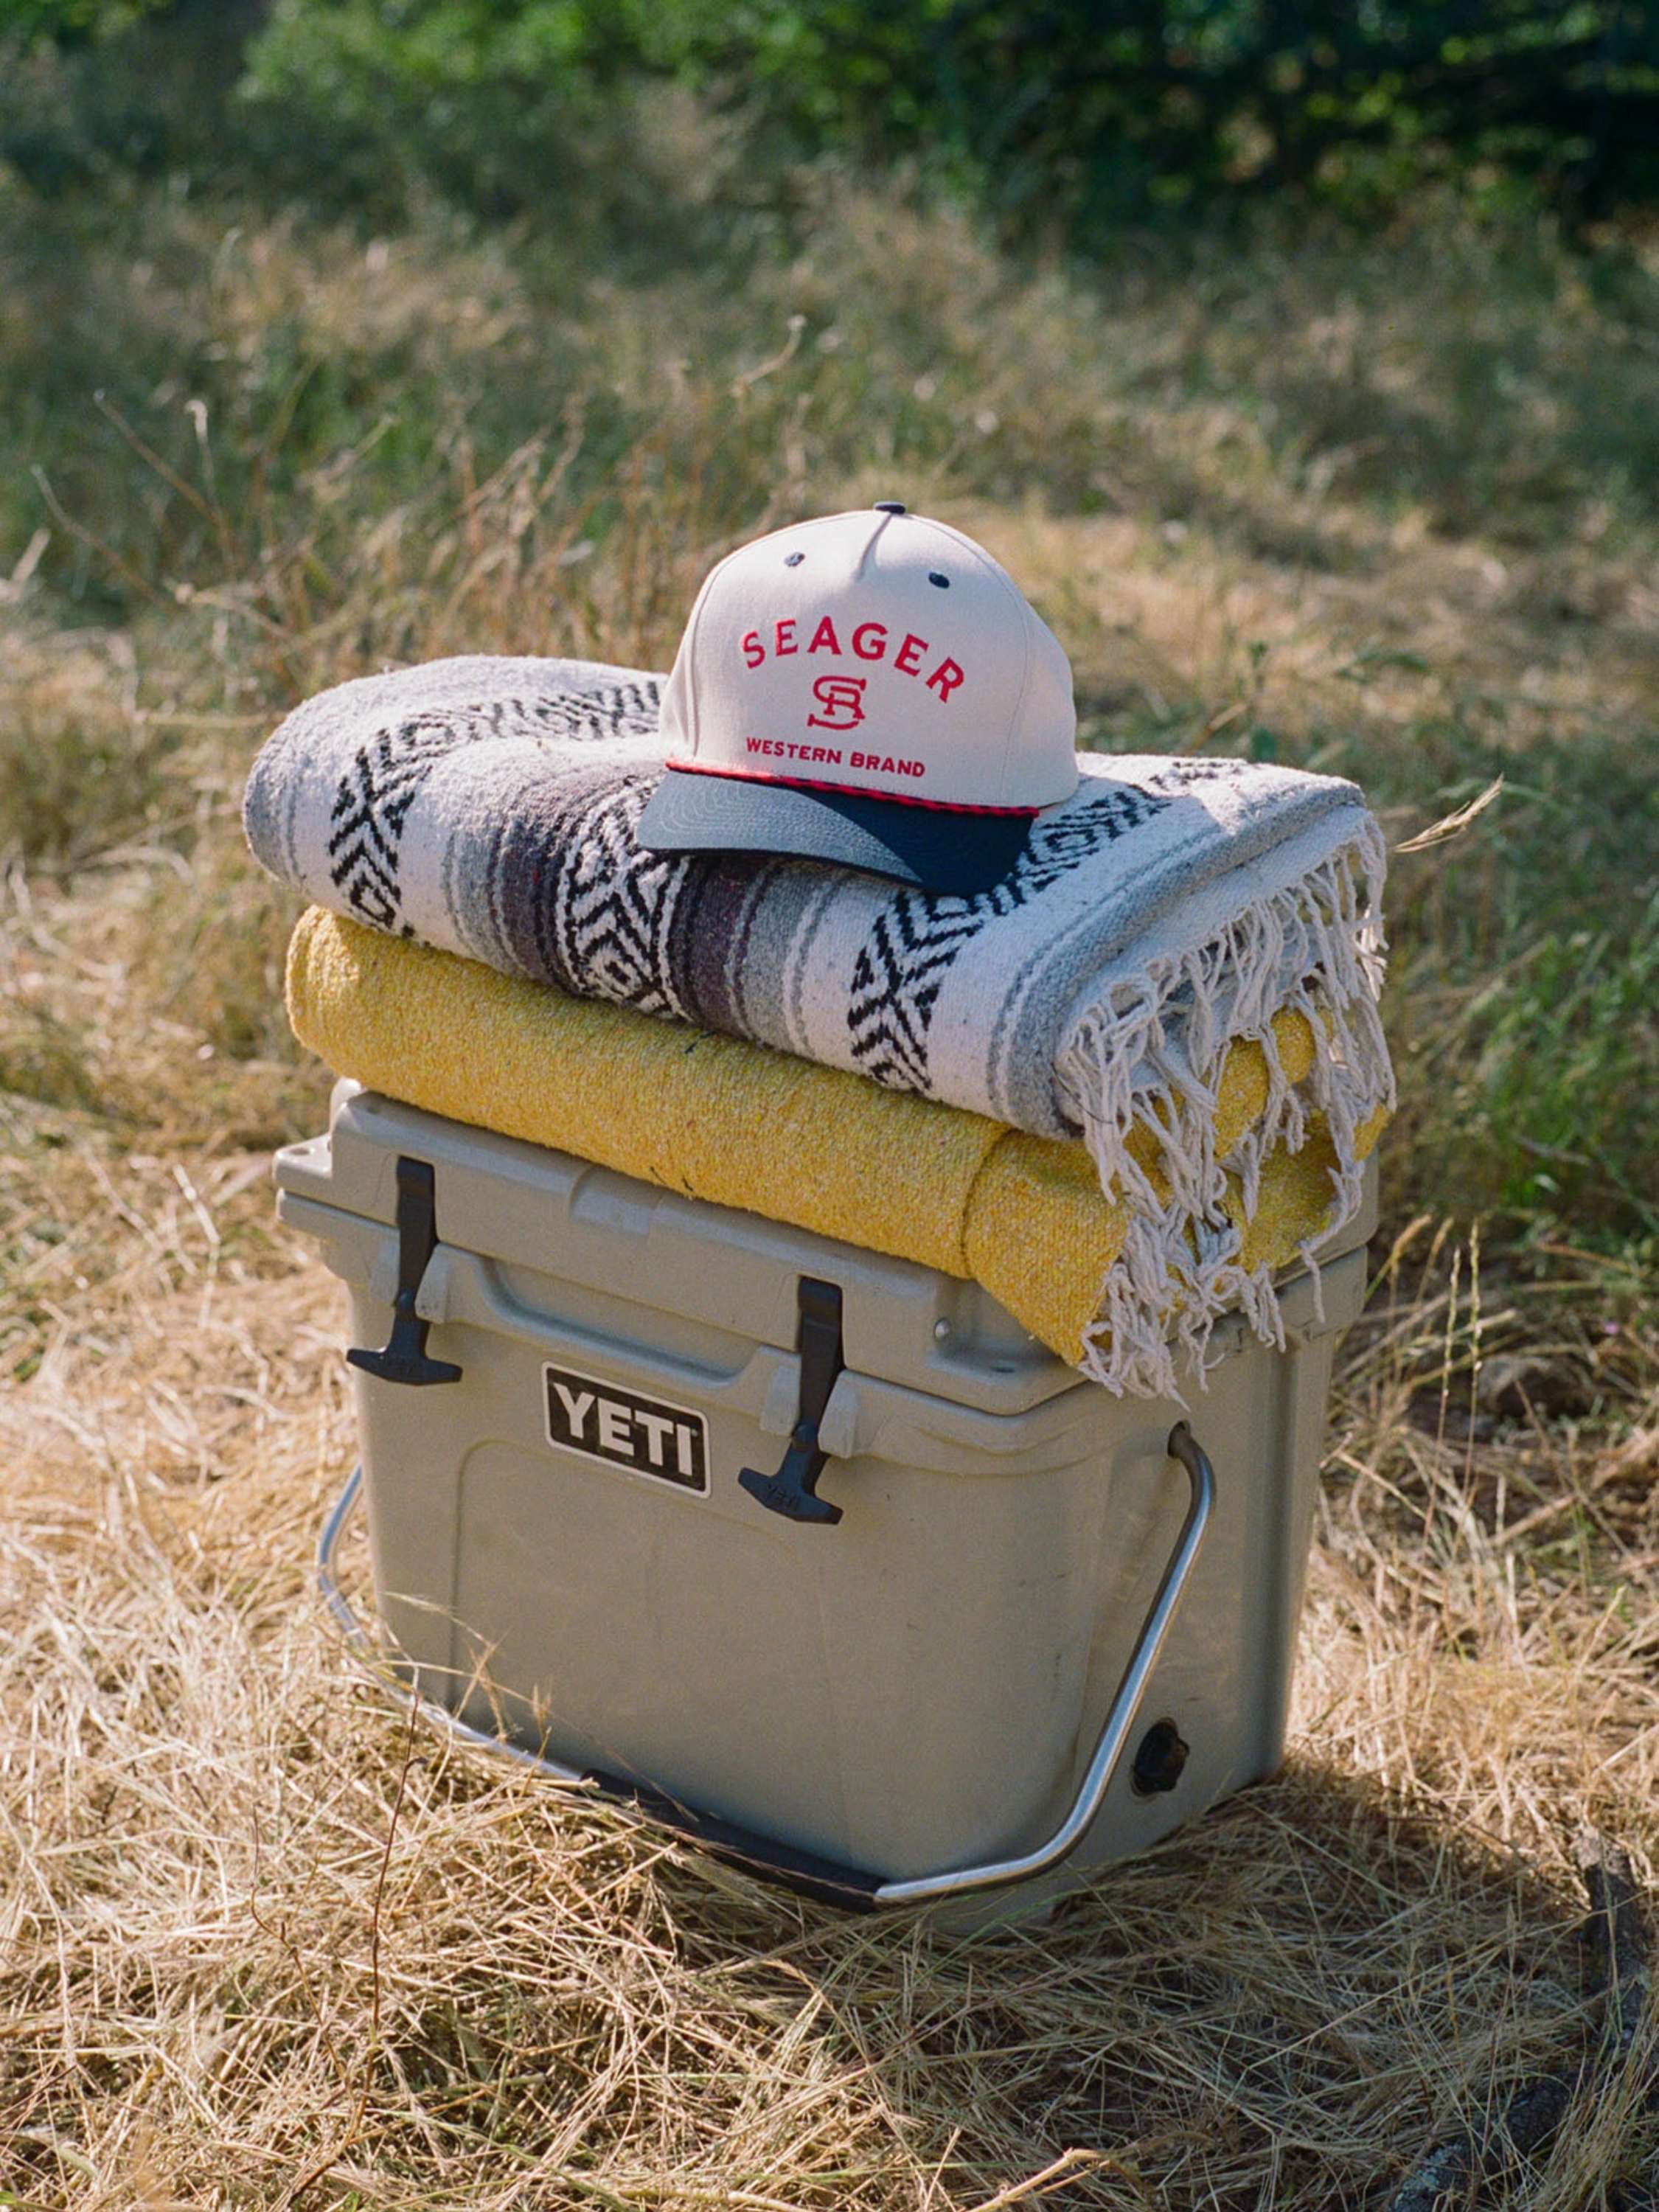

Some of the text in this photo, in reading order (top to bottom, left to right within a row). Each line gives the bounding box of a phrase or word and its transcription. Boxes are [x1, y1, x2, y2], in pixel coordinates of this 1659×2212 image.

[741, 616, 964, 703] SEAGER
[746, 737, 926, 778] WESTERN BRAND
[553, 1382, 694, 1477] YETI
